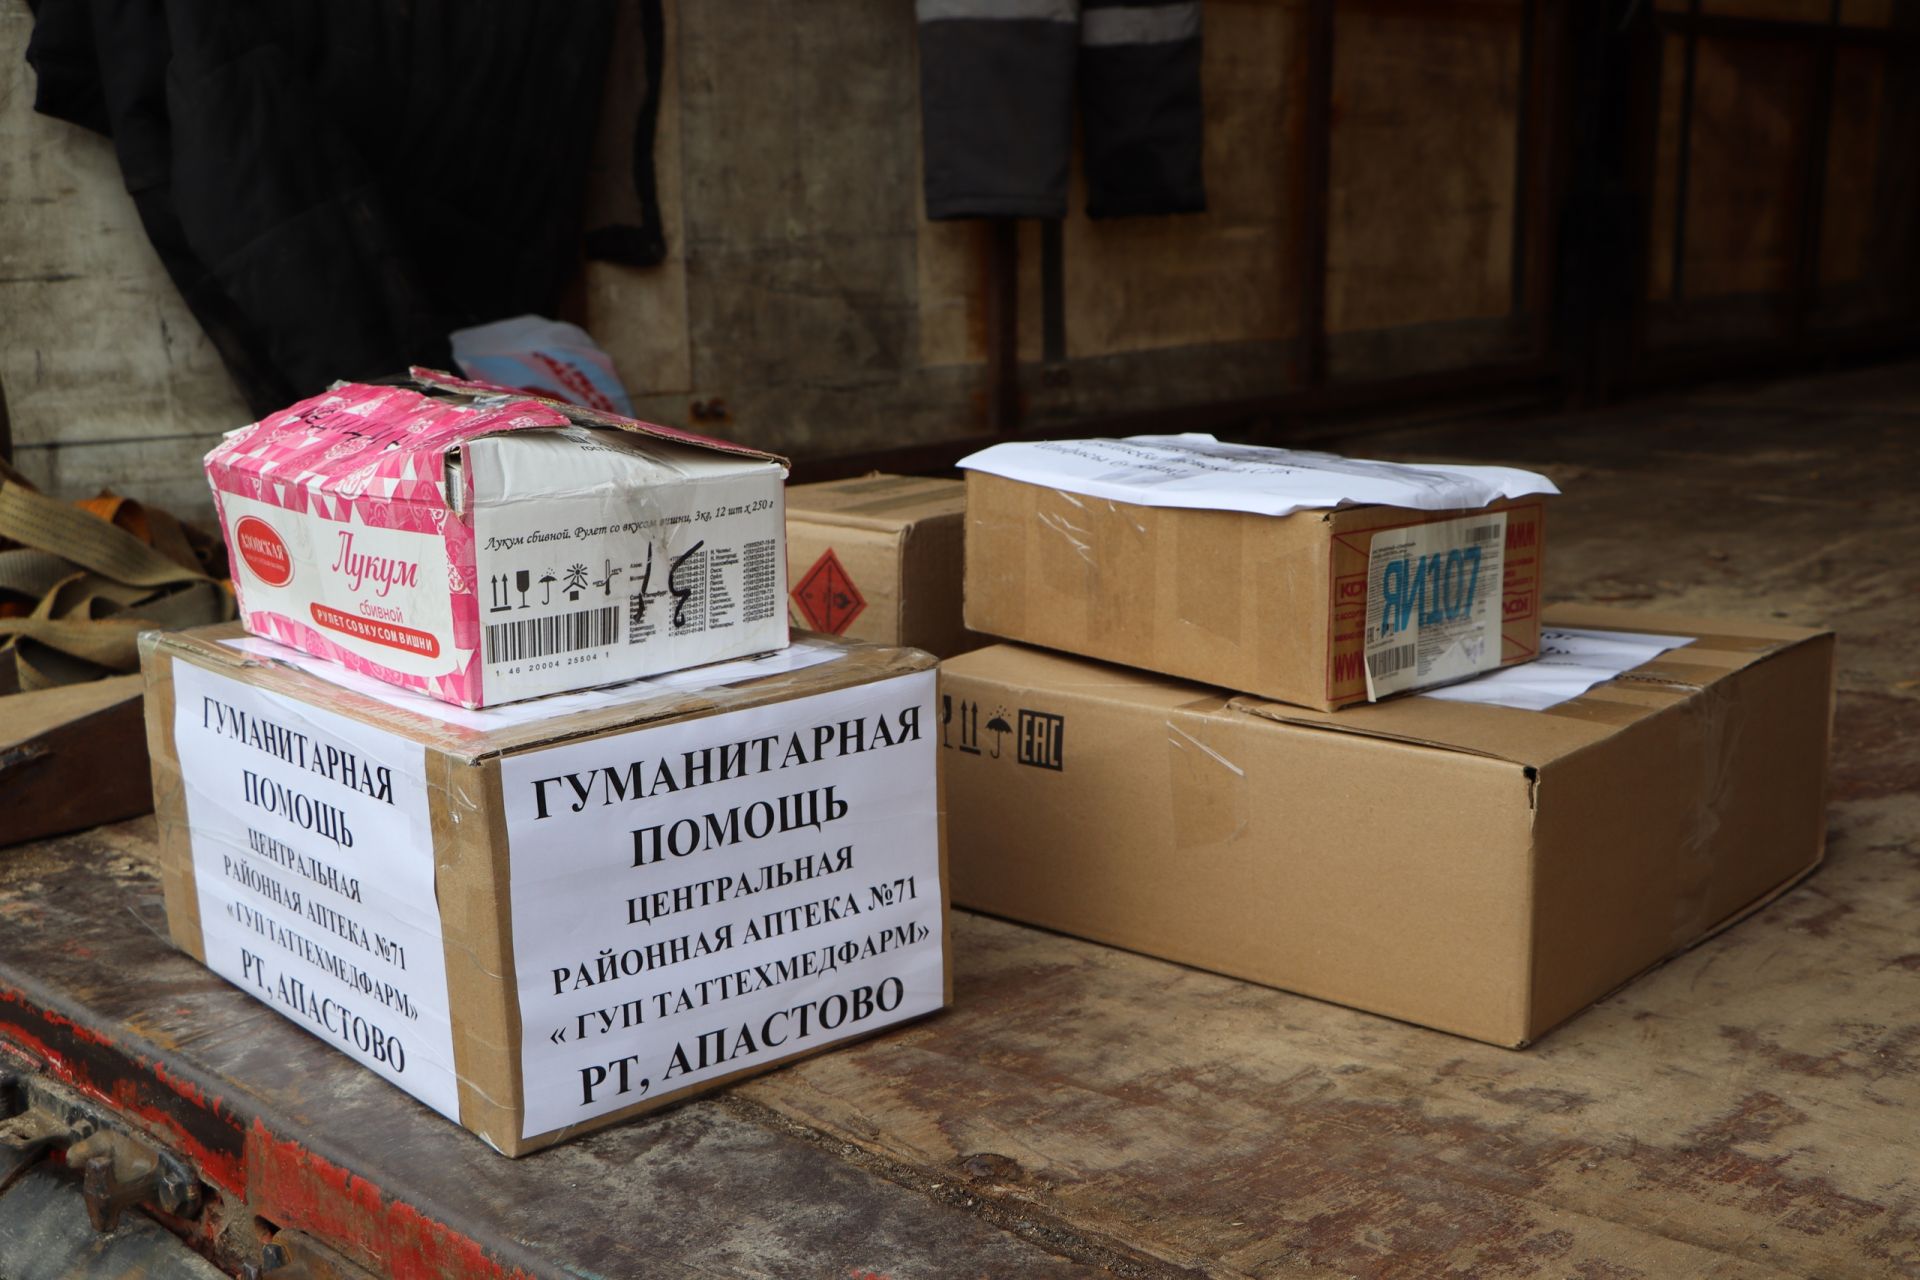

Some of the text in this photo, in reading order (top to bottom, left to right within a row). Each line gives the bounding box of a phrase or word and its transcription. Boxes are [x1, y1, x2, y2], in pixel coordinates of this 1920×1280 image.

[332, 530, 418, 598] Лукум
[484, 537, 524, 551] Лукум
[526, 529, 571, 543] сбивной.
[574, 526, 607, 540] Рулет
[609, 524, 620, 533] со
[715, 507, 726, 518] 12
[728, 505, 743, 515] шт
[752, 499, 768, 512] 250
[317, 608, 433, 652] РУЛЕТ СО ВКУСОМ ВИШНИ
[203, 696, 395, 805] ГУМАНИТАРНАЯ
[531, 705, 921, 820] ГУМАНИТАРНАЯ
[242, 769, 354, 851] ПОМОЩЬ
[630, 785, 849, 867] ПОМОЩЬ
[224, 854, 407, 971] РАЙОННАЯ АПТЕКА №71
[248, 828, 362, 903] ЦЕНТРАЛЬНАЯ
[626, 845, 854, 926] ЦЕНТРАЛЬНАЯ
[267, 918, 418, 1021] ТАТТЕХМЕДФАРМ»
[551, 876, 917, 995] РАЙОННАЯ АПТЕКА №71
[652, 921, 930, 1019] ТАТТЕХМЕДФАРМ»
[241, 947, 405, 1074] РТ, АПАСТОВО
[577, 976, 904, 1107] РТ, АПАСТОВО
